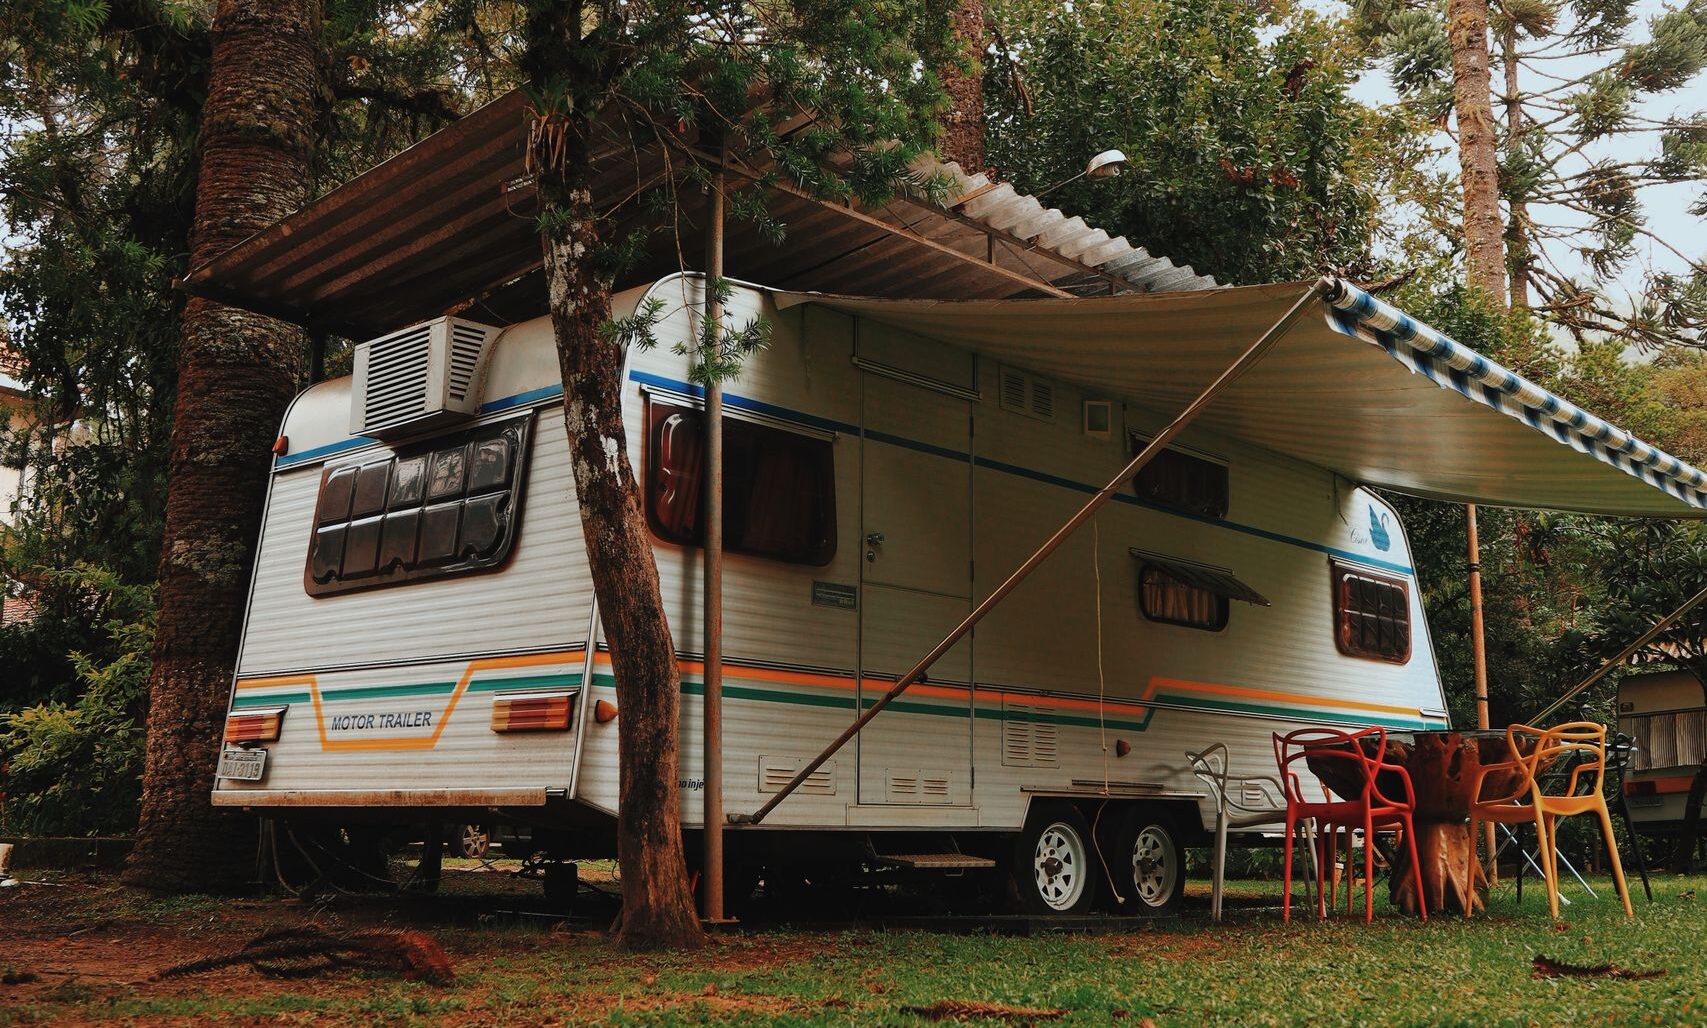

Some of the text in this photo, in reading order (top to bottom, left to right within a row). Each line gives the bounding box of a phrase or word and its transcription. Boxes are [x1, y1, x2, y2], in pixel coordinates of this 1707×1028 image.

[331, 711, 432, 730] MOTOR TRAILER
[688, 778, 704, 791] inje
